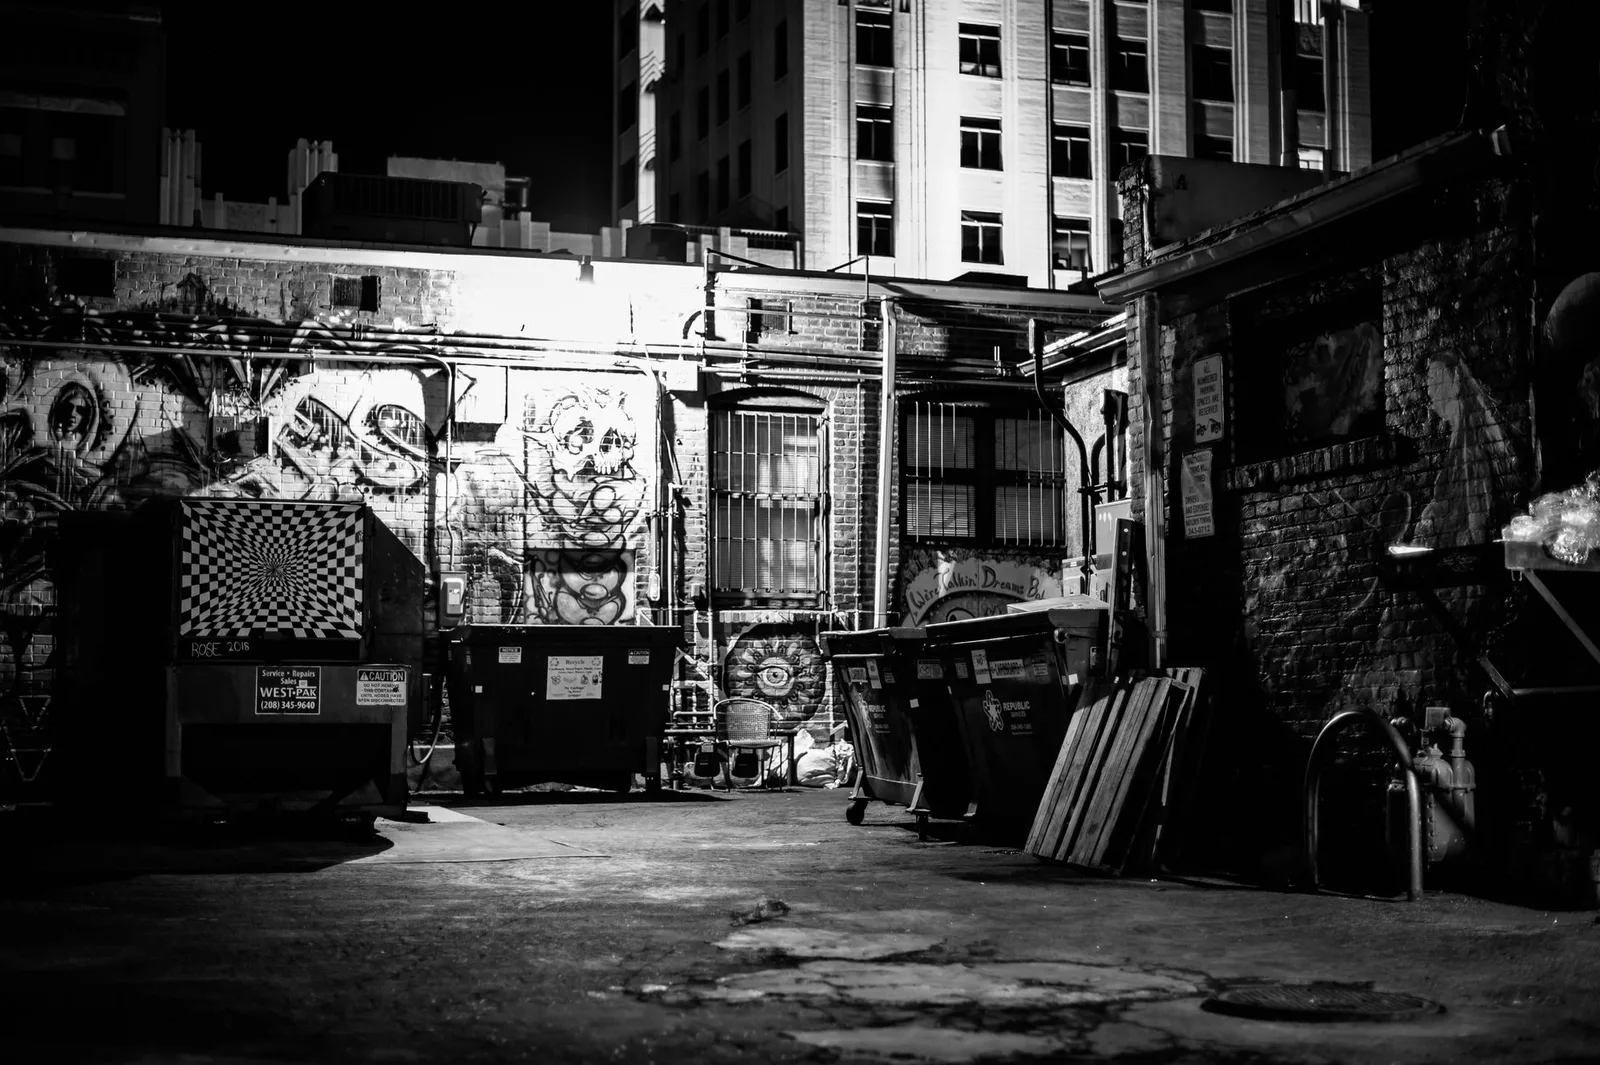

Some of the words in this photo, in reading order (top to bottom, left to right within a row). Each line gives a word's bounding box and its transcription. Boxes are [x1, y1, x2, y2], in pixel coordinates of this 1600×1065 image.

[1196, 396, 1210, 406] SPACES
[1199, 404, 1218, 416] RESERVED
[934, 568, 978, 591] Talkin'
[981, 566, 1024, 594] Dreams
[191, 642, 223, 658] ROSE
[226, 641, 250, 652] 2018
[292, 670, 316, 678] Repairs
[370, 671, 404, 681] CAUTION
[260, 700, 280, 710] (208)
[281, 700, 315, 710] 345-9640
[1002, 700, 1032, 711] REPUBLIC
